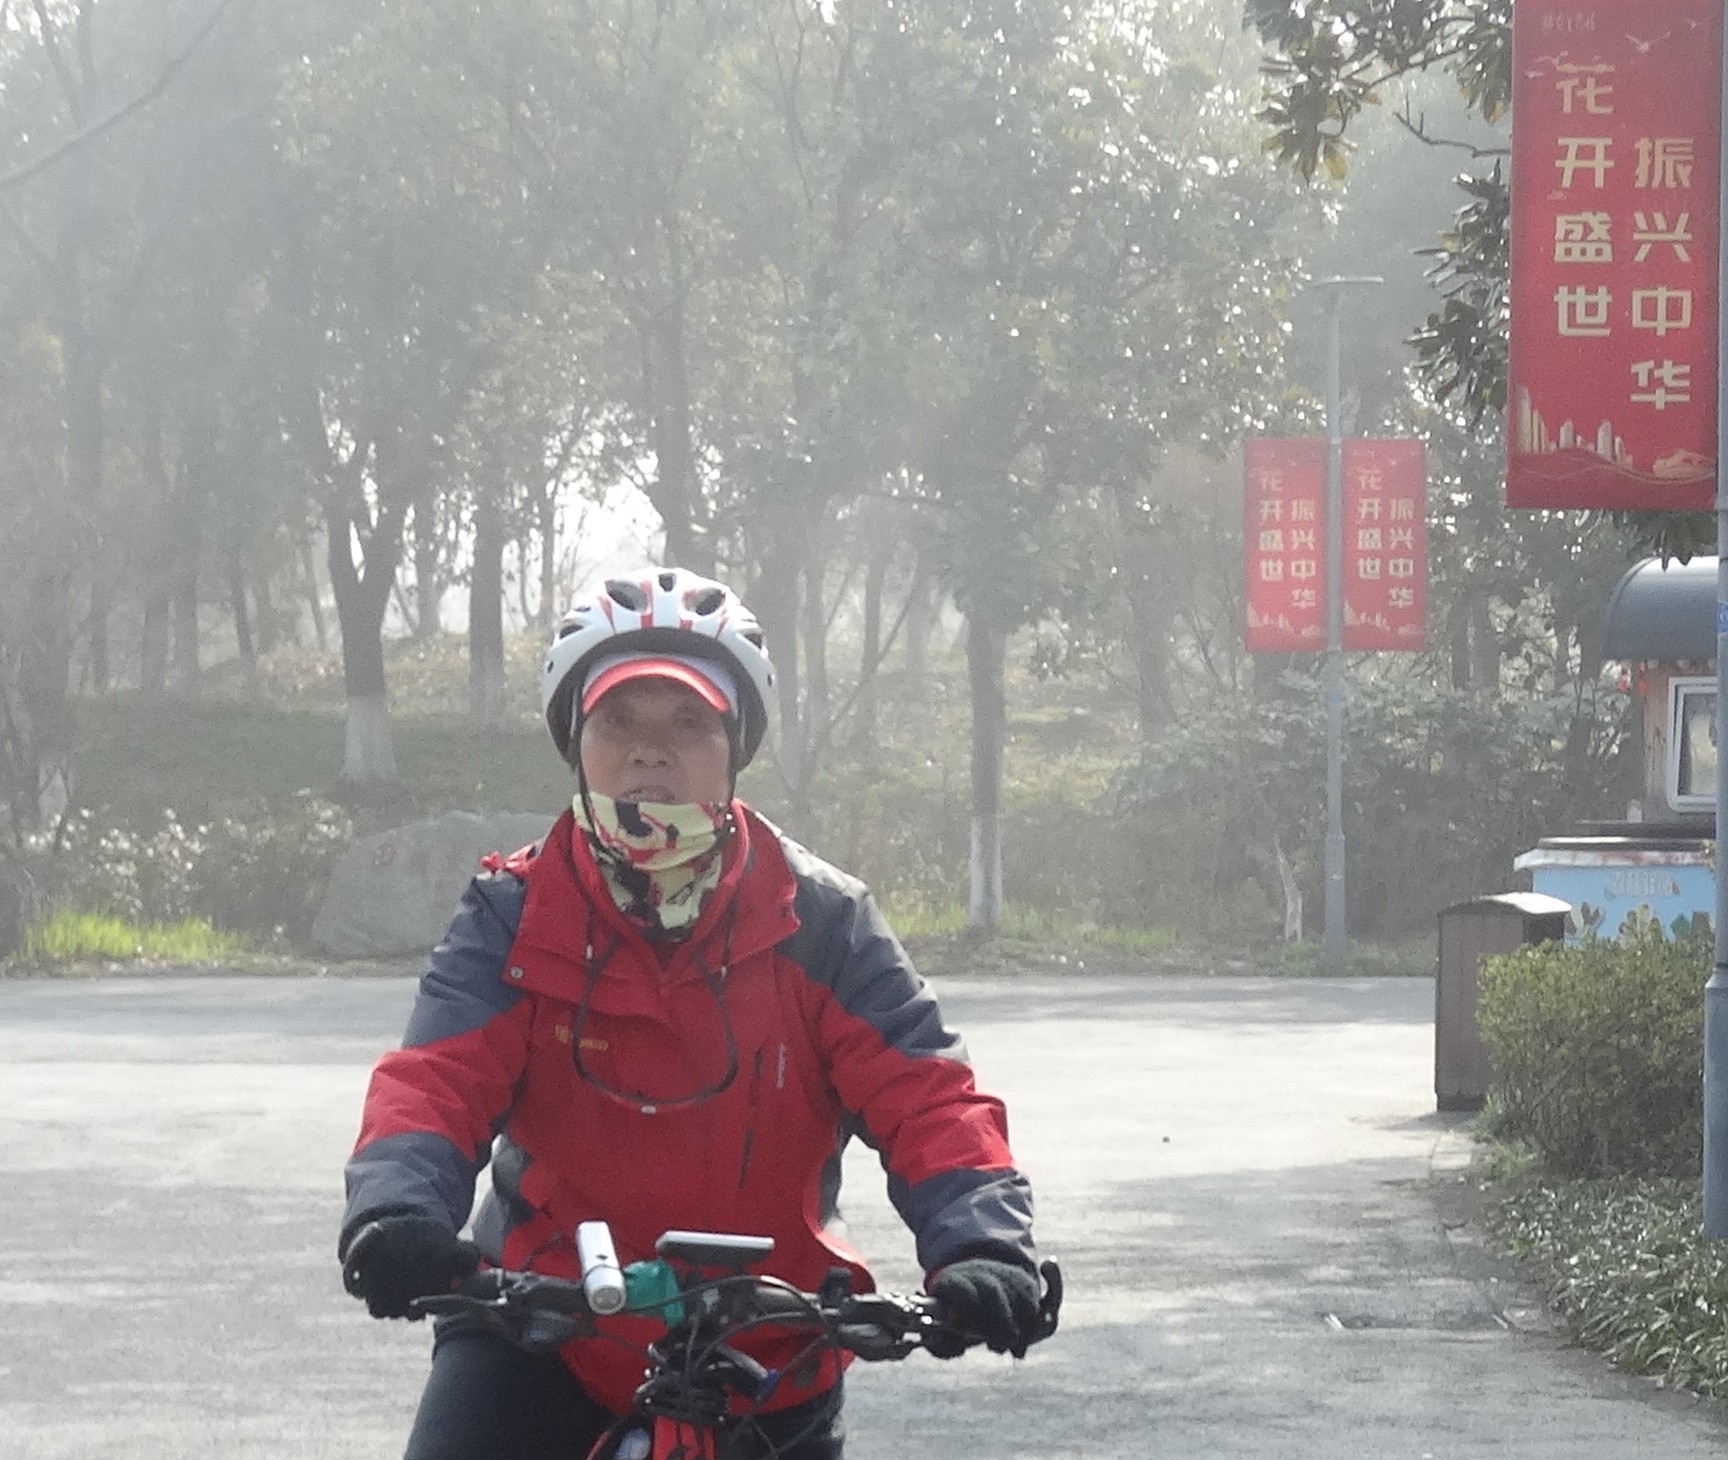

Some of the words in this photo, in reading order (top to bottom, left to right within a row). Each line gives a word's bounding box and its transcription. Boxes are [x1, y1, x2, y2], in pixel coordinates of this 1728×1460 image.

[1554, 63, 1615, 337] 花开盛世
[1631, 137, 1693, 410] 振兴中华
